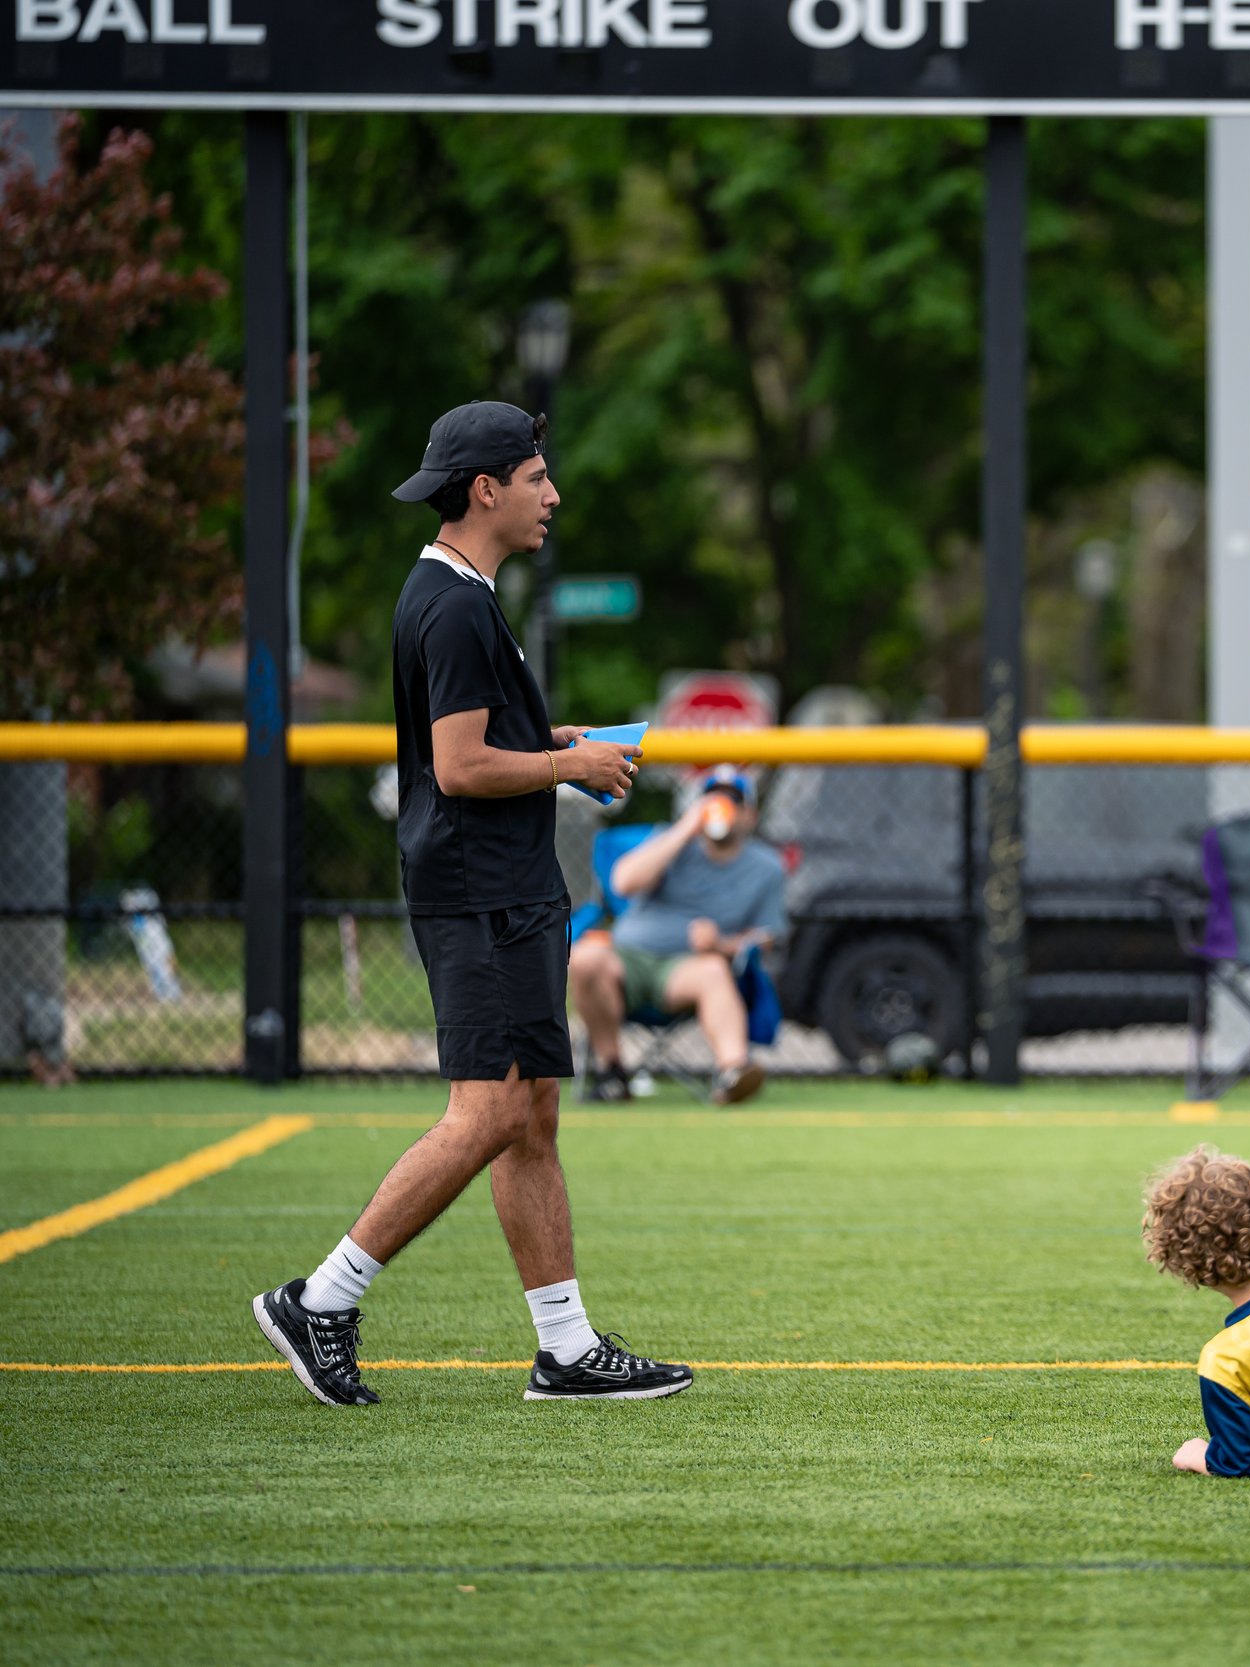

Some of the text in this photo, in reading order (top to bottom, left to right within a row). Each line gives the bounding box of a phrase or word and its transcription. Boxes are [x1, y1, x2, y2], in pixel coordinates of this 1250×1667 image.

[15, 0, 267, 44] BALL
[376, 0, 712, 48] STRIKE
[788, 0, 985, 49] OUT
